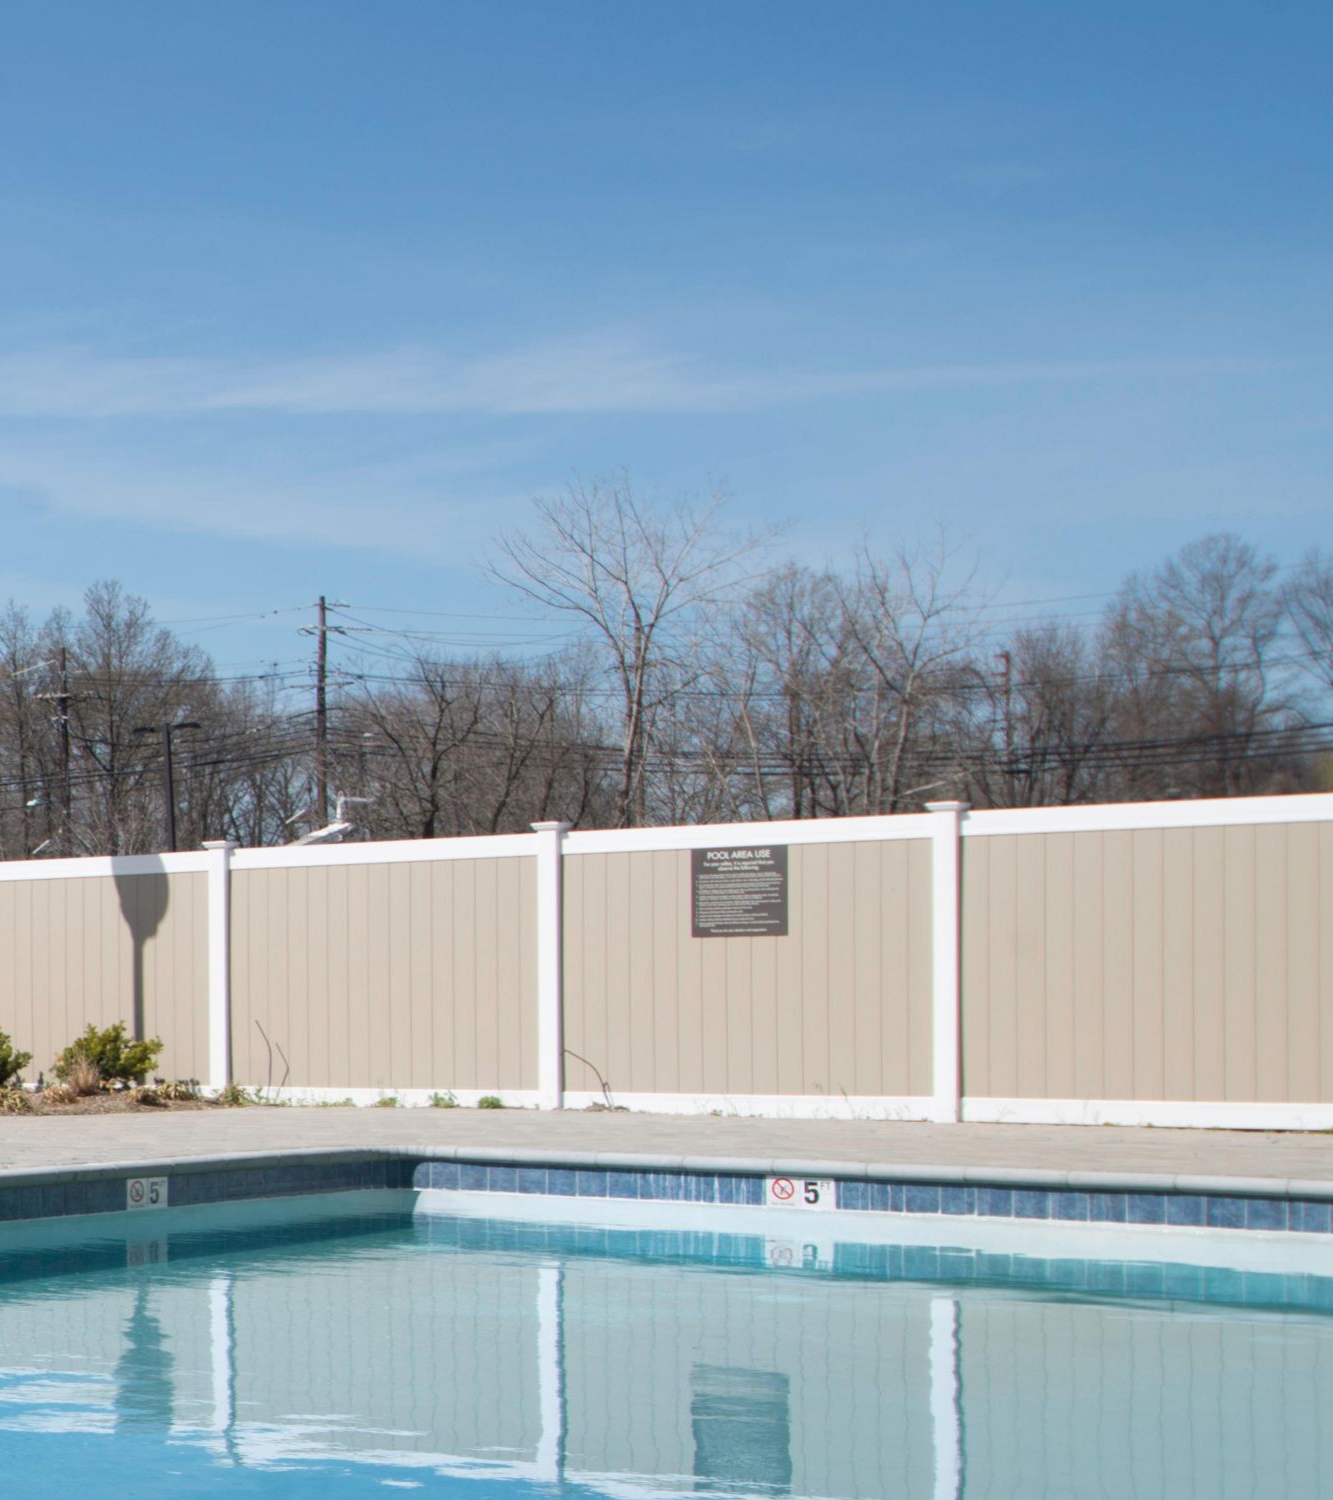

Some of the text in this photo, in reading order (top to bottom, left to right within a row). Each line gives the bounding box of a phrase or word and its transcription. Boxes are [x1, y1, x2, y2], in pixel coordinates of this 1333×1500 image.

[707, 849, 771, 860] POOL AREA USE
[149, 1181, 160, 1205] 5
[803, 1181, 832, 1205] 5 FT
